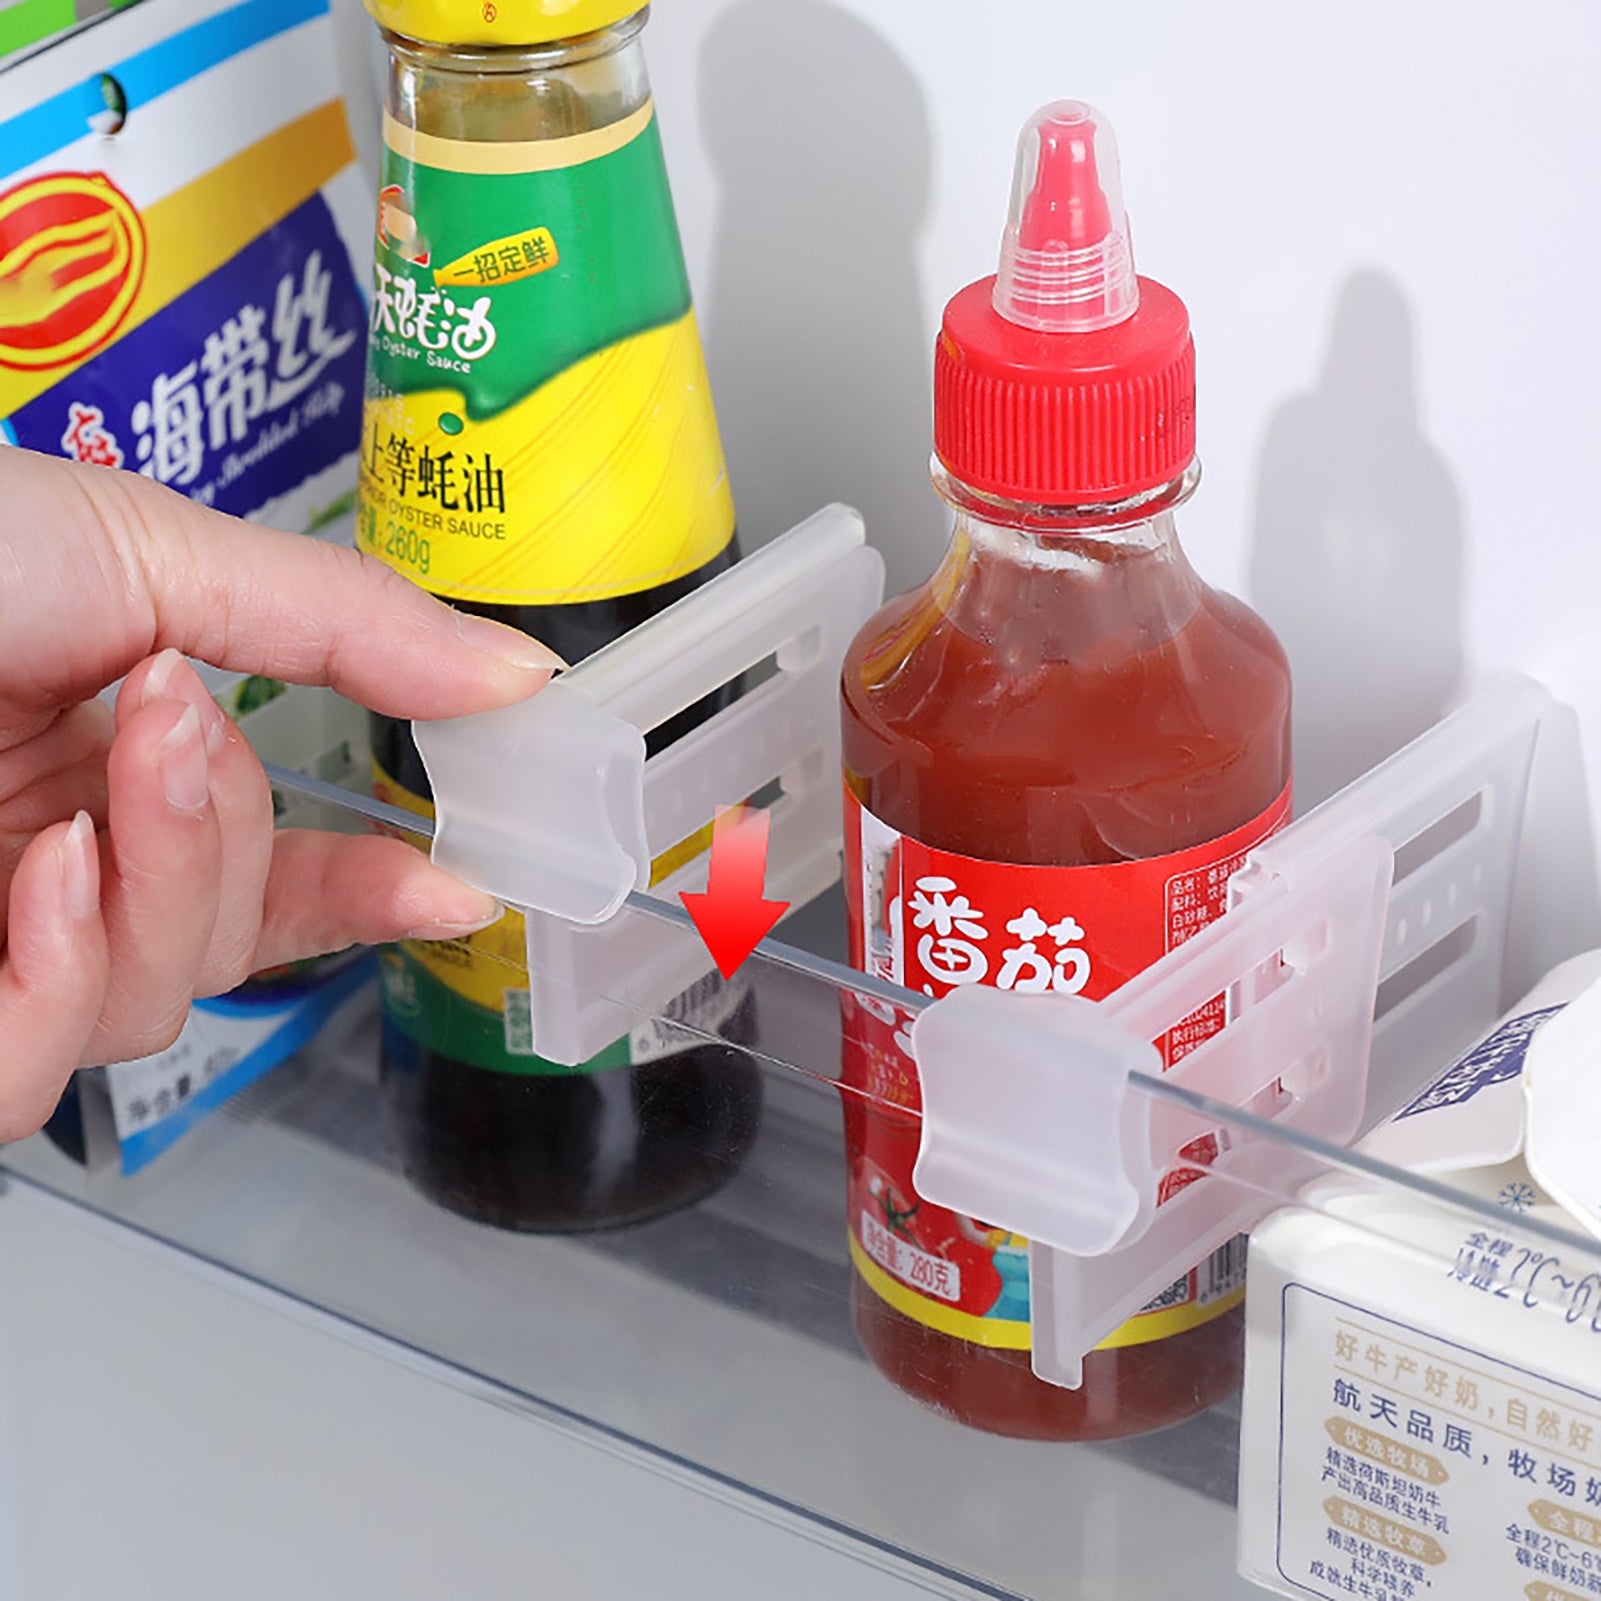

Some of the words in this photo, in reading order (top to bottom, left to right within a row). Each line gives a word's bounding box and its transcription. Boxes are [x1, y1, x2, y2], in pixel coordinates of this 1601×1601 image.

[453, 235, 550, 284] 一招定鲜
[131, 248, 358, 487] 海带丝
[426, 349, 472, 374] Sauce
[362, 420, 506, 515] 上等蚝油
[388, 497, 444, 530] OYSTER
[447, 516, 507, 540] SAUCE
[907, 875, 1091, 995] 番茄
[1465, 1231, 1514, 1259] 全程
[1344, 1426, 1431, 1479] 优选牧场
[1321, 1464, 1450, 1535] 产出高品质生牛乳
[1549, 1509, 1601, 1549] 全程
